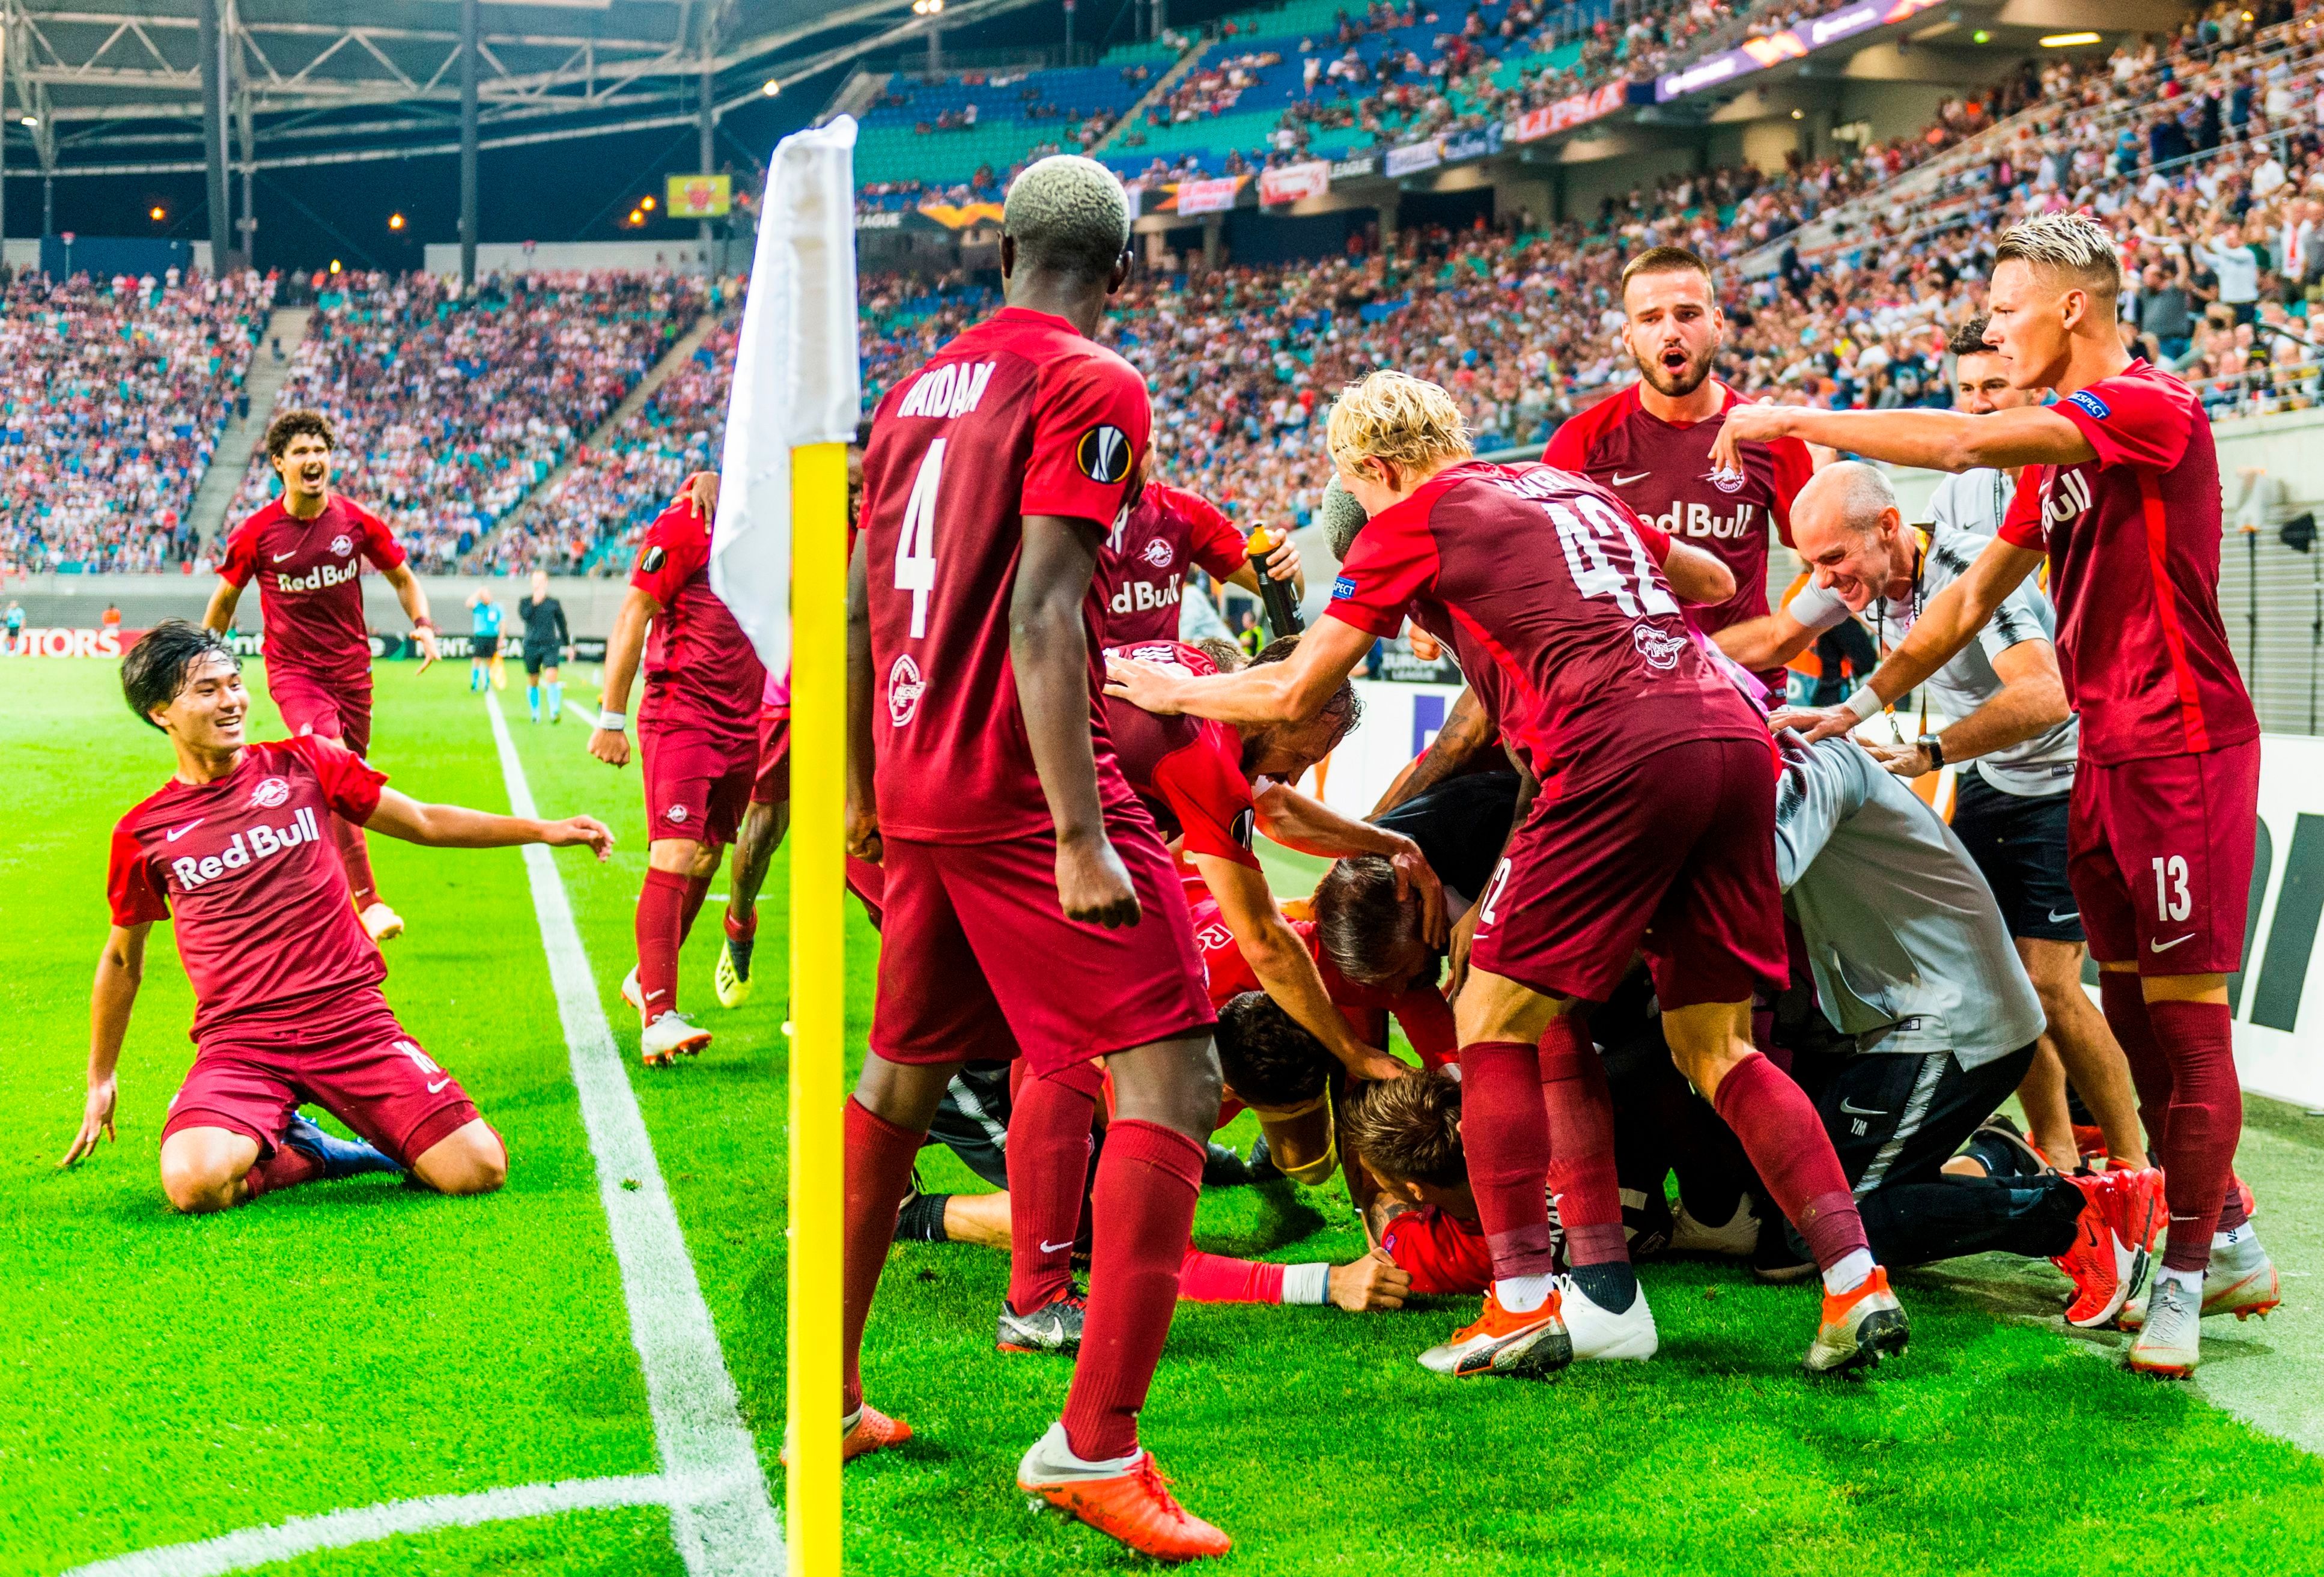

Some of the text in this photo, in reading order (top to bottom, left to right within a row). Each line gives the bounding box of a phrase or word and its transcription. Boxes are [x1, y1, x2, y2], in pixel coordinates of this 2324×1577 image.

[894, 437, 948, 639] 4
[1687, 503, 1753, 538] Bull
[277, 558, 357, 592] Red Bull
[1541, 494, 1681, 618] 42
[1134, 573, 1181, 612] Bull
[172, 807, 320, 891] Red Bull
[2152, 855, 2192, 922] 13
[1851, 1117, 1867, 1137] YM
